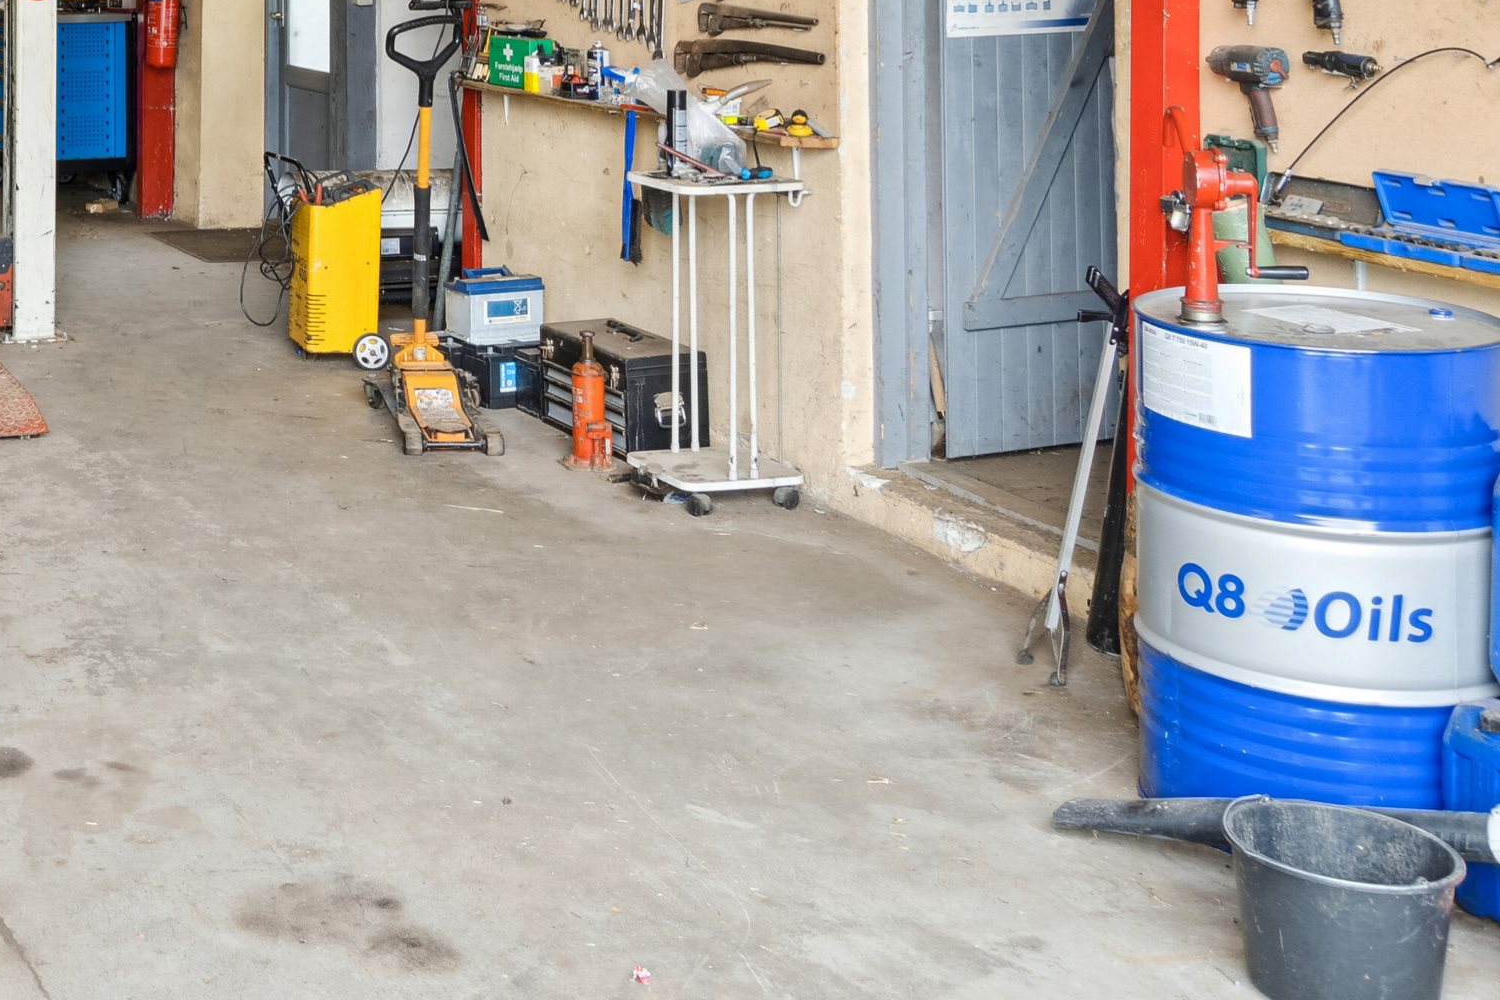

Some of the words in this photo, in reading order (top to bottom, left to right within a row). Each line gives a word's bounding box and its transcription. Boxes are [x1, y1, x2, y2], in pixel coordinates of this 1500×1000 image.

[499, 72, 510, 81] First
[510, 74, 520, 83] Aid
[1177, 562, 1246, 619] Q8
[1313, 591, 1434, 643] Oils
